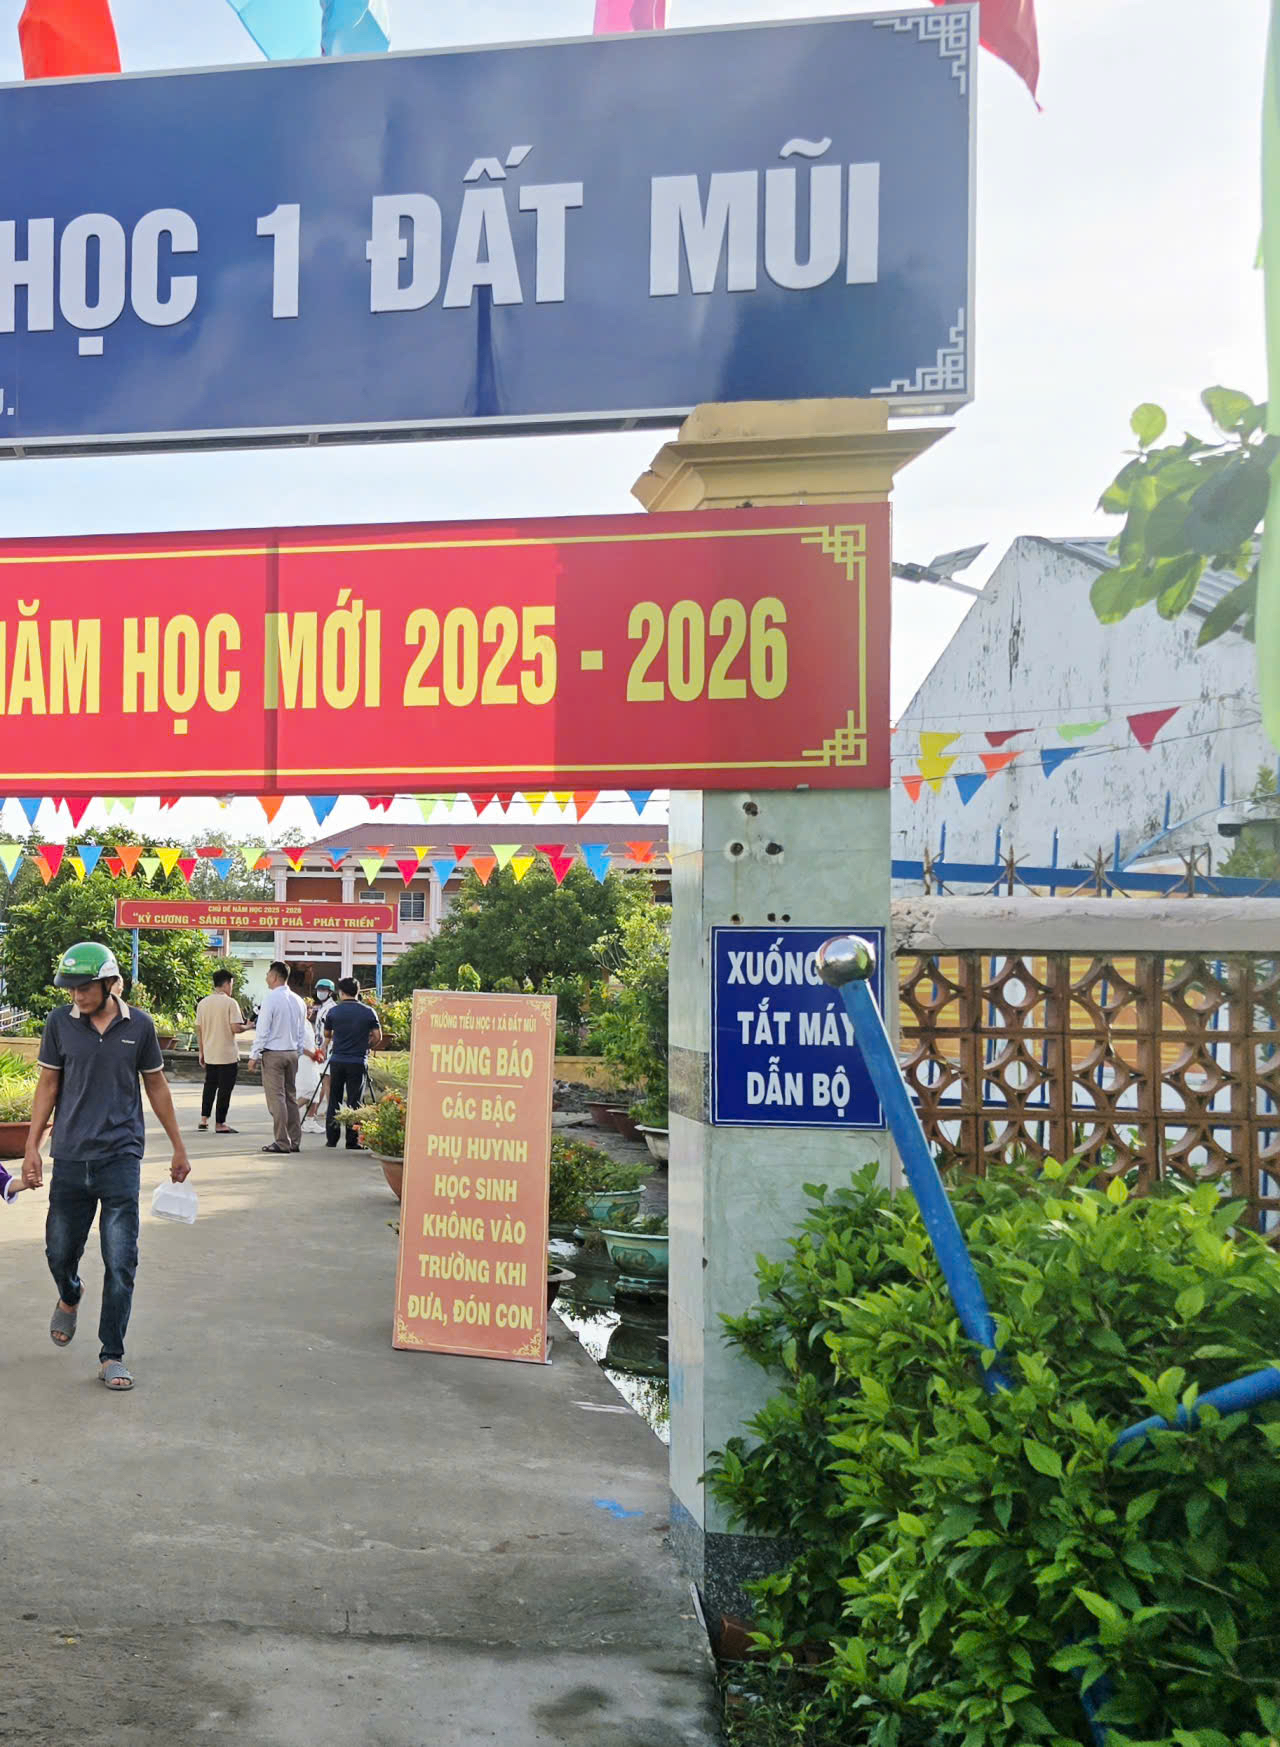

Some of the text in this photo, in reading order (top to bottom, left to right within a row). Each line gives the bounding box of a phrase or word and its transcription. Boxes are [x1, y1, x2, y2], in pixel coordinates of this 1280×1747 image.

[257, 204, 300, 317] 1
[366, 145, 583, 312] ĐẤT
[650, 137, 880, 295] MŨI
[123, 613, 240, 734] HỌC
[264, 589, 380, 709] MỚI
[404, 606, 556, 706] 2025
[580, 651, 602, 670] -
[627, 597, 787, 701] 2026
[154, 914, 189, 924] CƯƠNG
[199, 914, 227, 925] SÁNG
[230, 916, 249, 927] TẠO
[259, 916, 280, 927] ĐỘT
[282, 917, 304, 926] PHÁ
[313, 917, 341, 927] PHÁT
[431, 1010, 457, 1029] TRƯỜNG
[459, 1008, 474, 1030] TIỂU
[476, 1016, 490, 1034] HỌC
[508, 1011, 522, 1032] ĐẤT
[737, 997, 854, 1046] TẮT MÁY
[431, 1038, 534, 1078] THÔNG BÁO
[747, 1056, 850, 1117] DẪN BỘ
[442, 1092, 516, 1127] CÁC BẬC
[427, 1135, 528, 1164] PHỤ HUYNH
[434, 1174, 517, 1204] HỌC SINH
[423, 1214, 526, 1245] KHÔNG VÀO
[419, 1252, 526, 1286] TRƯỜNG KHI
[407, 1292, 533, 1330] ĐƯA, ĐÓN CON
